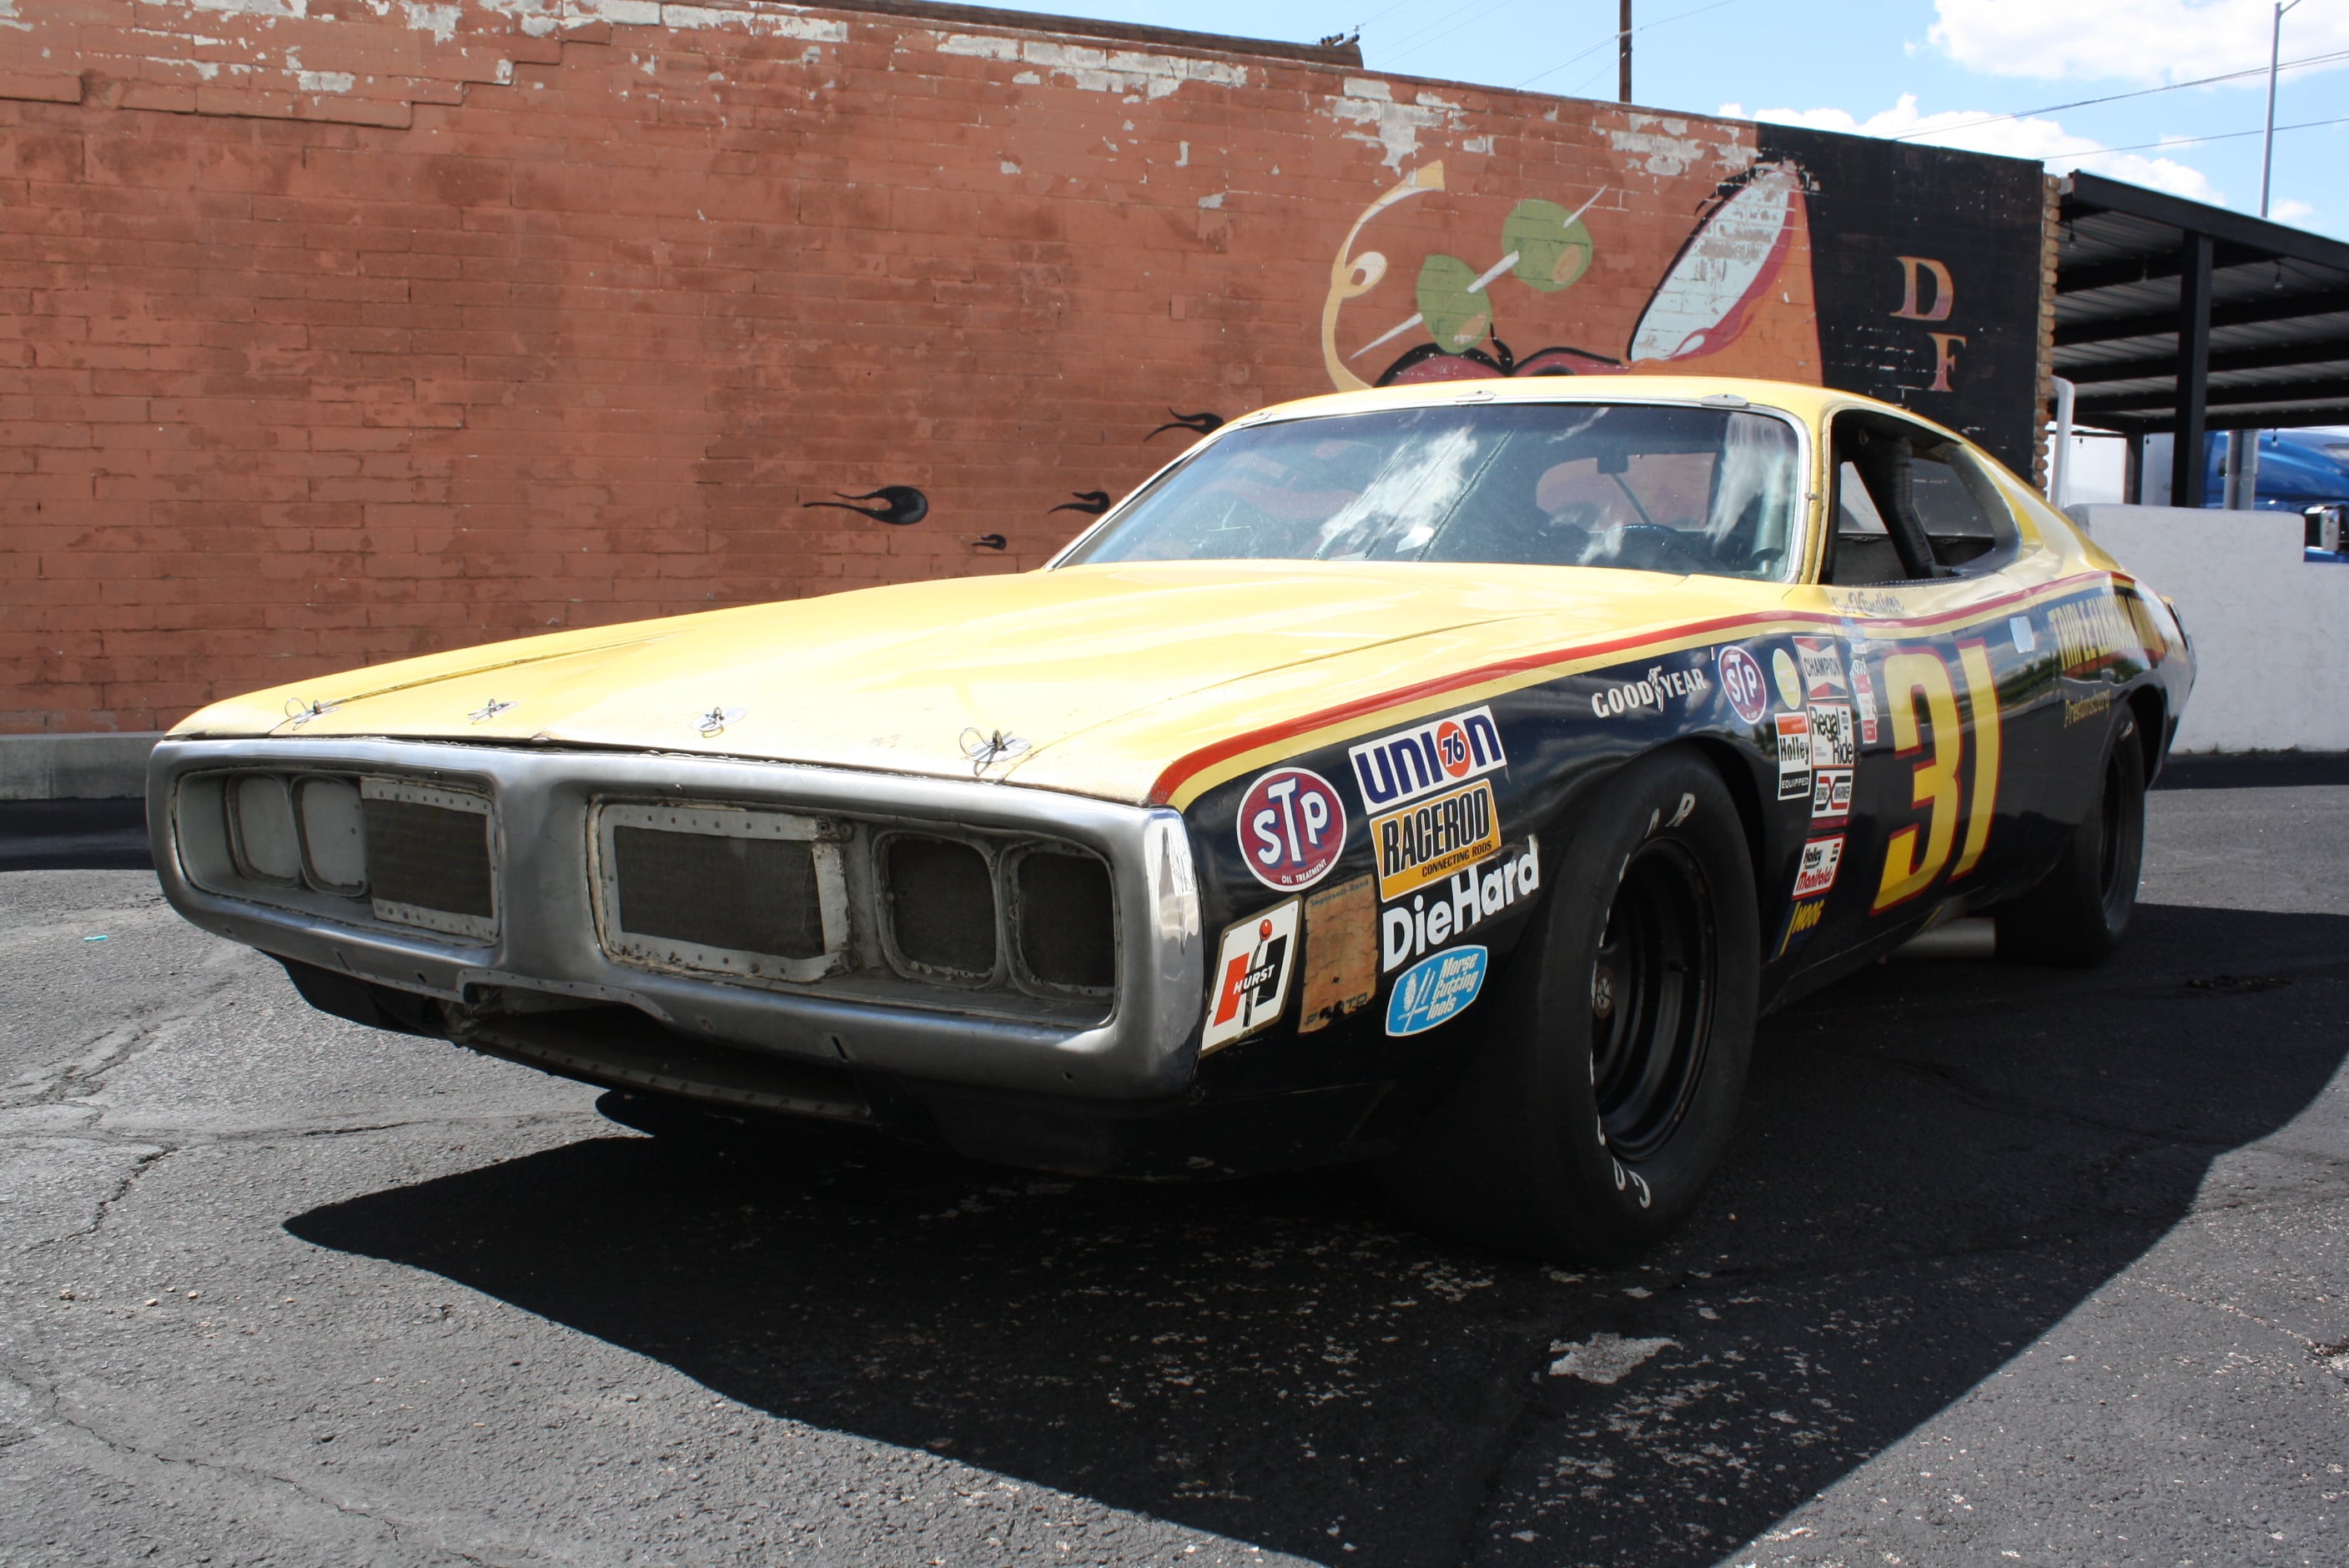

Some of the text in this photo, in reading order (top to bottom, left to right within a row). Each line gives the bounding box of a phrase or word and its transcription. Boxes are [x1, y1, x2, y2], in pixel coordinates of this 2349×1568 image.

[1889, 256, 1954, 321] D
[1928, 333, 1966, 392] F
[1725, 653, 1760, 707] STP
[1803, 657, 1842, 677] CHAMPION
[1808, 706, 1841, 742] Regal
[1441, 729, 1466, 767] 76
[1779, 736, 1809, 766] Holley
[1832, 736, 1853, 764] Ride
[1781, 776, 1809, 789] EQUIPPED
[1869, 637, 2002, 915] 31
[1253, 776, 1330, 867] STP
[1381, 787, 1491, 878] RACEROD
[1281, 858, 1327, 884] OIL TREATMENT
[1421, 849, 1470, 877] CONNECTING
[1471, 841, 1492, 859] RODS
[1803, 847, 1823, 867] Holley
[1310, 879, 1370, 907] Ingersoll-Rand
[1382, 835, 1540, 973] DieHard
[1233, 963, 1275, 995] HURST
[1439, 953, 1480, 979] Morse
[1432, 971, 1479, 1001] Cutting
[1426, 995, 1457, 1022] Tools
